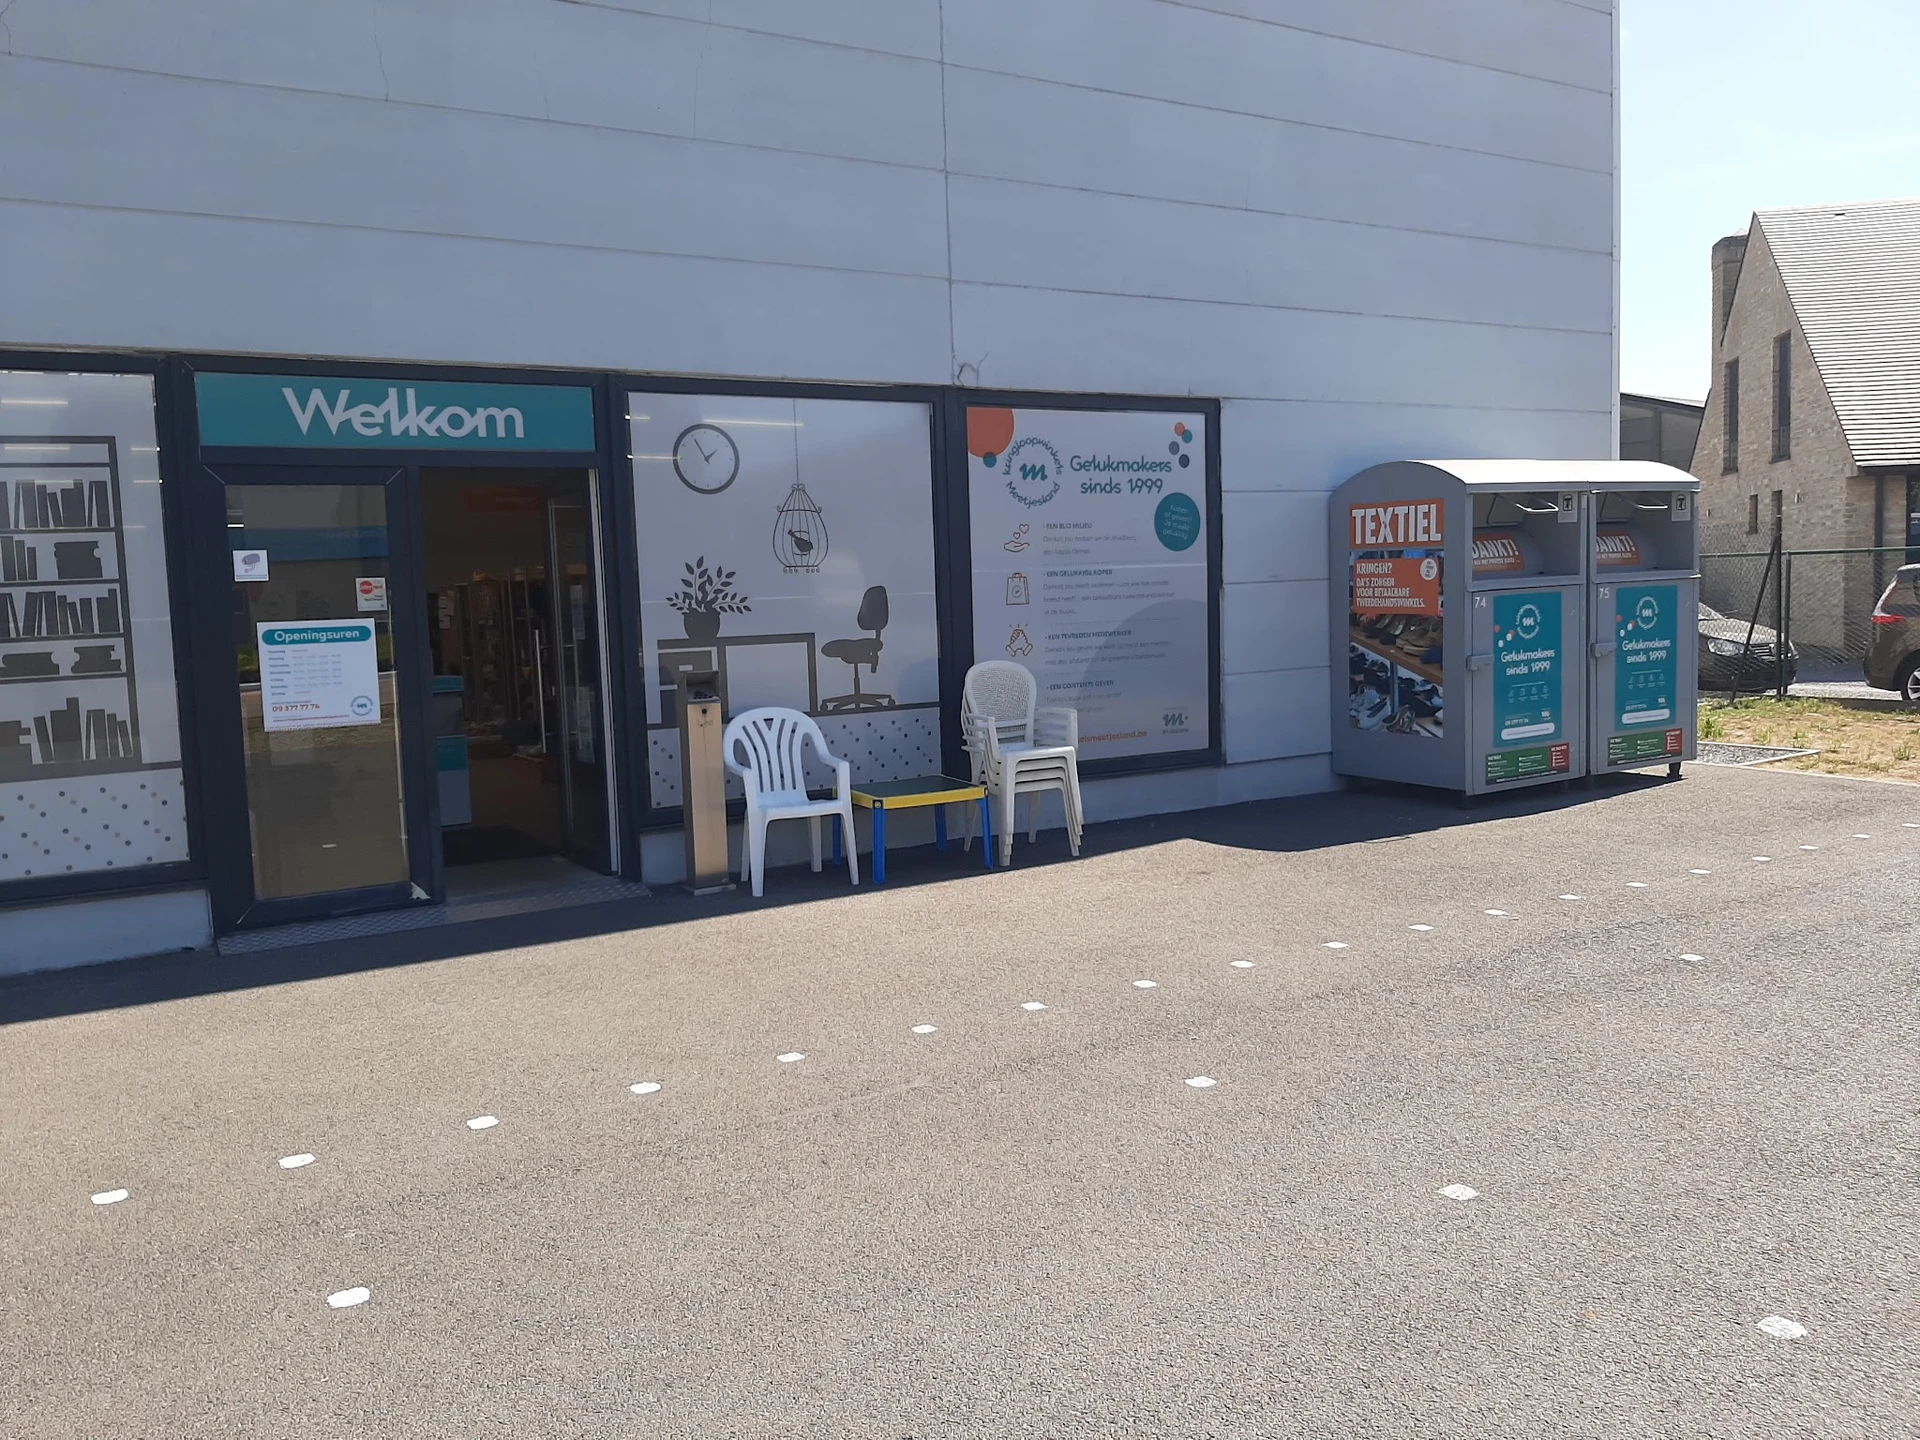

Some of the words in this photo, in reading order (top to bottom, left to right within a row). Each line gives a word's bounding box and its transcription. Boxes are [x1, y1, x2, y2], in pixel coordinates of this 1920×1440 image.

[282, 387, 525, 439] Welkom
[1002, 437, 1064, 476] kringloopwinkels
[1070, 455, 1172, 473] Gelukmakers
[1080, 477, 1122, 495] sinds
[1127, 478, 1164, 495] 1999
[1005, 481, 1060, 510] Meetjesland
[1351, 504, 1442, 545] TEXTIEL
[1472, 539, 1519, 559] DANKT!
[1597, 535, 1635, 552] ANKT!
[1356, 562, 1392, 574] KRINGEN?
[1370, 577, 1394, 587] ZORGEN
[1356, 588, 1373, 597] VOOR
[1374, 587, 1410, 597] BETAALBARE
[1599, 588, 1610, 600] 75
[1474, 597, 1486, 609] 74
[274, 629, 360, 645] Openingsuren
[1622, 638, 1671, 652] Gelukmakers
[1501, 648, 1555, 663] Gelukmakers
[1506, 663, 1528, 676] sinds
[1530, 660, 1551, 673] 1999
